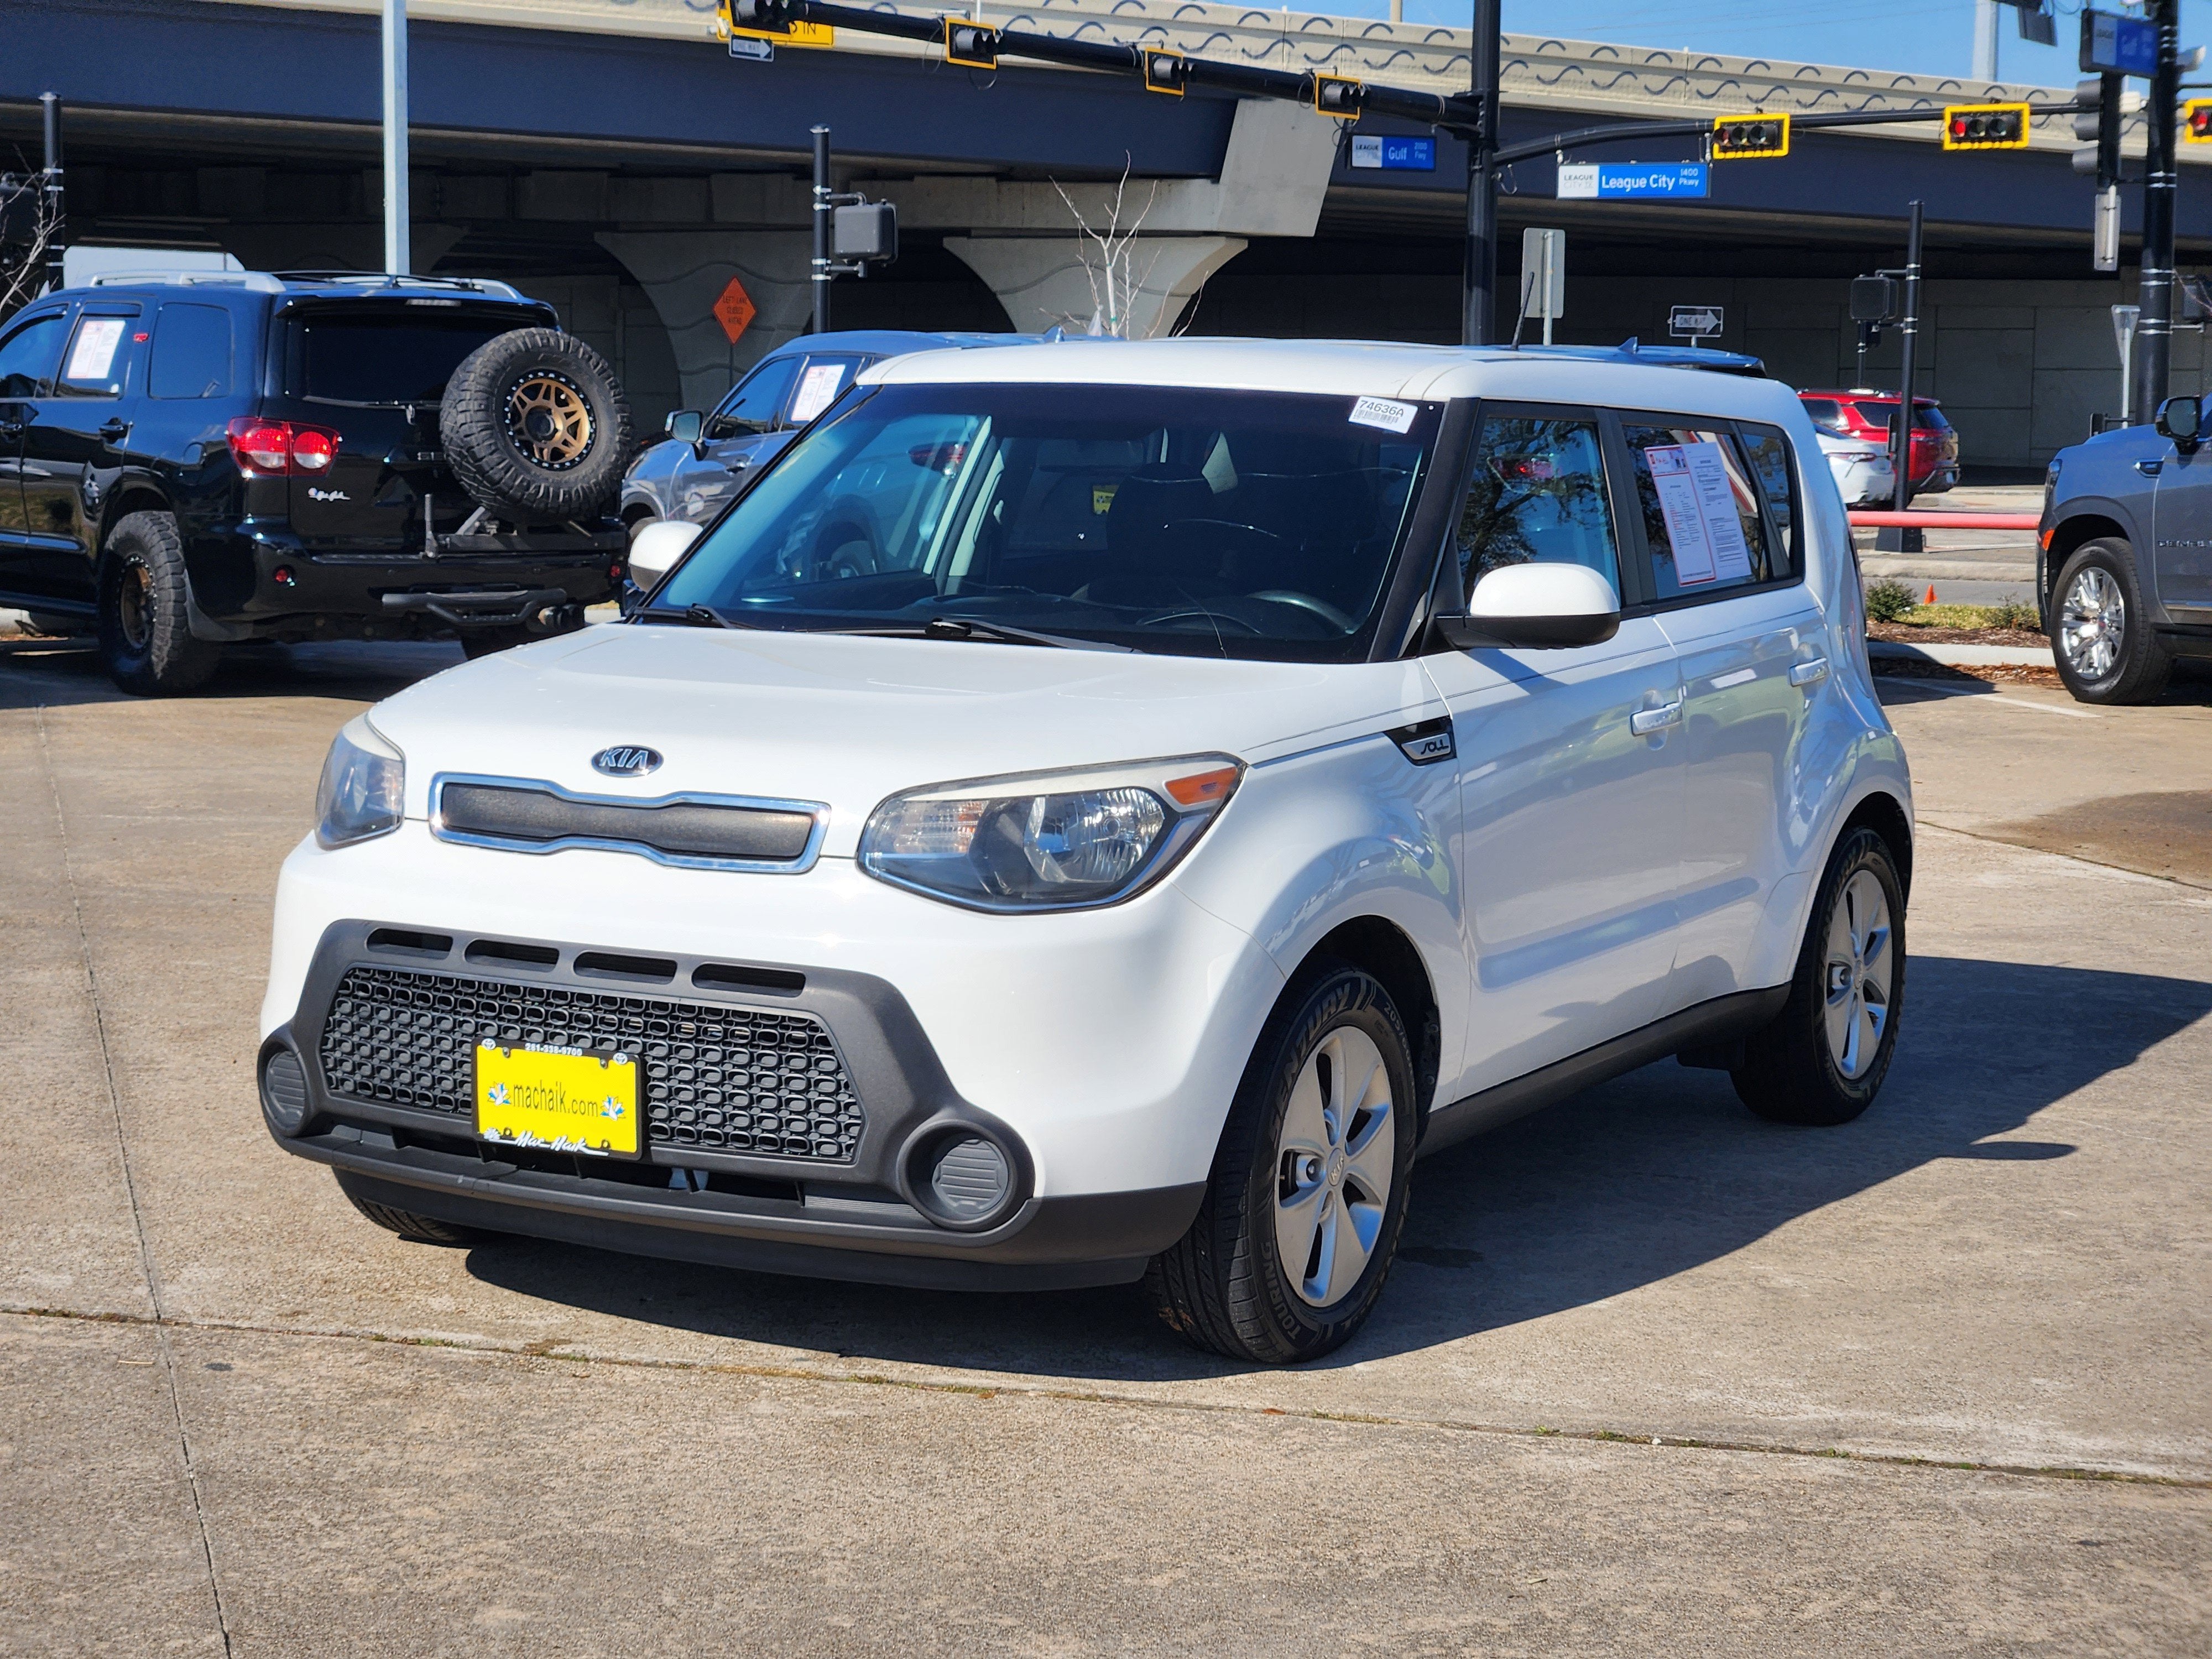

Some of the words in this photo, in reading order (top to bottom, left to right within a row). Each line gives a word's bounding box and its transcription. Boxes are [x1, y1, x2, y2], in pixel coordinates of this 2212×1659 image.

[1388, 146, 1407, 160] Gulf
[1680, 168, 1699, 176] 1400
[1601, 175, 1647, 192] League
[1649, 174, 1676, 191] City
[1360, 400, 1404, 416] 74636A
[598, 748, 649, 769] KIA
[513, 1079, 598, 1117] machaik.com
